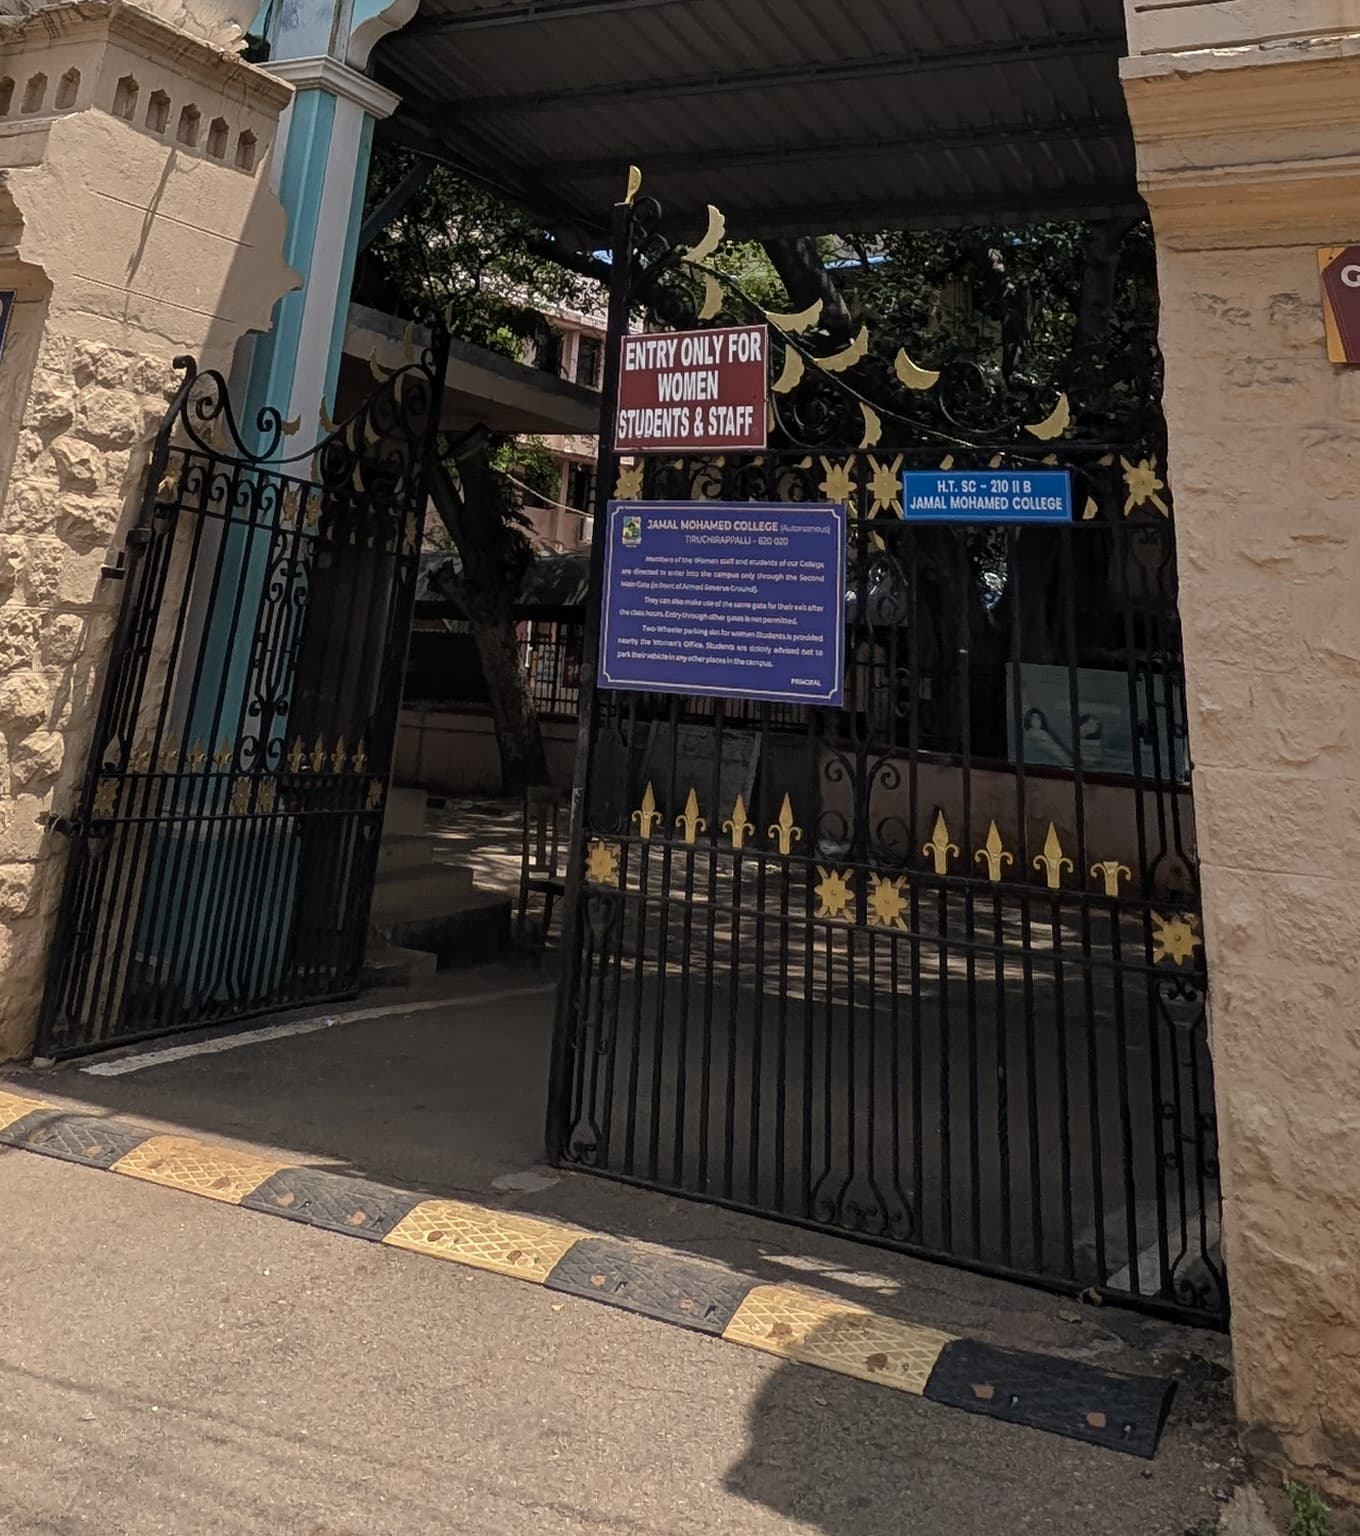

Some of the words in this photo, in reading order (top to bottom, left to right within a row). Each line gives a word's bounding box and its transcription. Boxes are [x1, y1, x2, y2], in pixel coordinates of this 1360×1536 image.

[625, 339, 678, 371] ENTRY
[681, 335, 724, 366] ONLY
[728, 332, 761, 363] FOR
[658, 370, 719, 402] WOMEN
[618, 407, 690, 439] STUDENTS
[694, 406, 704, 437] &
[708, 406, 753, 436] STAFF
[937, 480, 958, 493] H.T.
[961, 480, 976, 493] SC
[990, 479, 1008, 493] 210
[1023, 480, 1032, 493] B
[910, 496, 946, 510] JAMAL
[950, 496, 1008, 510] MOHAMED
[1012, 497, 1063, 510] COLLEGE
[647, 519, 678, 530] JAMAL
[681, 520, 731, 532] MOHAMED
[733, 521, 778, 532] COLLEGE
